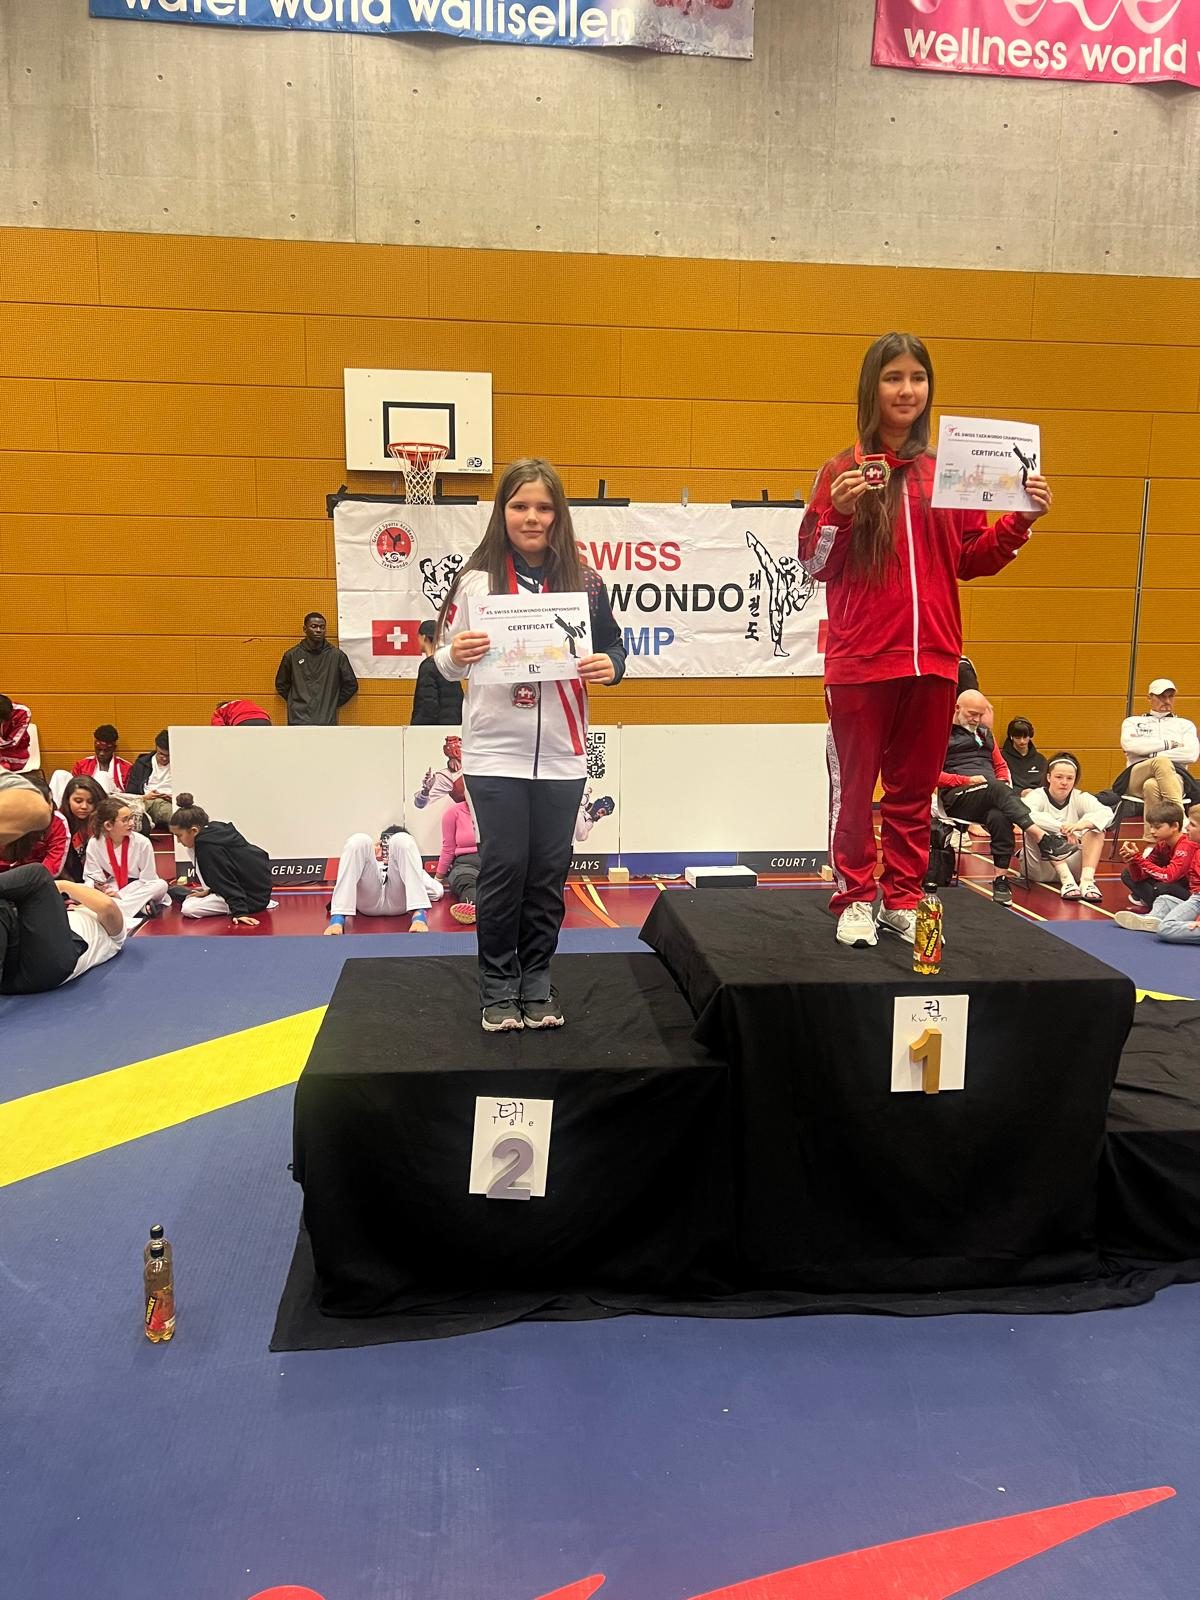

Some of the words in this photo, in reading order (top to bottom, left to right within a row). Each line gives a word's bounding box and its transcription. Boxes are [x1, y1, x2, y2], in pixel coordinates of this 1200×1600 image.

[272, 0, 391, 24] world
[406, 0, 635, 38] wallisellen
[903, 27, 1067, 71] wellness
[1081, 37, 1187, 75] world
[971, 449, 1012, 458] CERTIFICATE
[507, 623, 555, 632] CERTIFICATE
[770, 857, 807, 867] COURT
[811, 858, 817, 867] 1
[271, 864, 323, 875] GEN3.DE
[911, 1013, 948, 1023] Kwon
[908, 1028, 942, 1094] 1
[486, 1137, 534, 1201] 2
